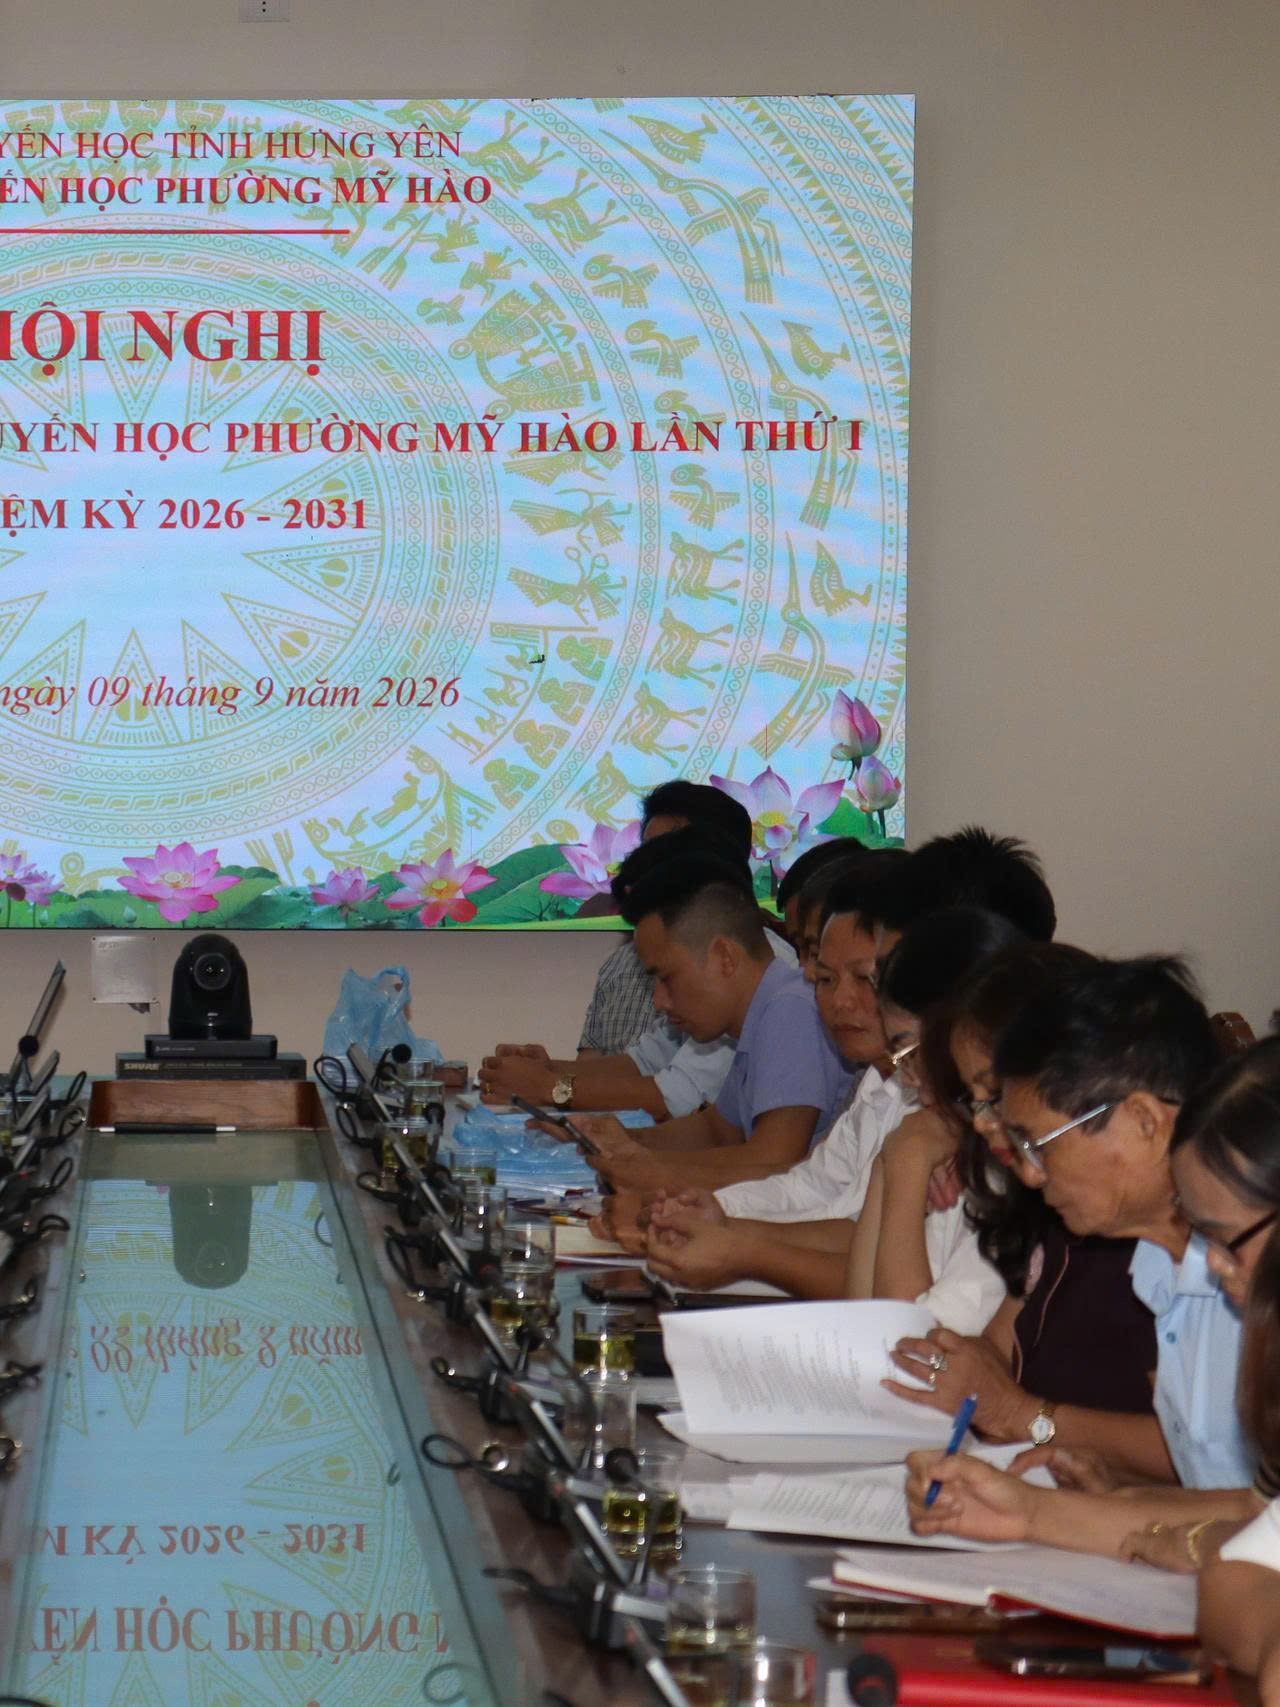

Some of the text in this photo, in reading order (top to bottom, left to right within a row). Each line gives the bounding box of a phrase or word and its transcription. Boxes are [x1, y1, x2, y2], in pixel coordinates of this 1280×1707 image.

[76, 131, 155, 164] HỌC
[164, 124, 253, 159] TỈNH
[265, 128, 375, 159] HƯNG
[386, 123, 462, 159] YÊN
[59, 176, 144, 212] HỌC
[154, 168, 321, 204] PHƯỜNG
[334, 170, 395, 204] MỸ
[404, 168, 492, 204] HÀO
[128, 308, 326, 376] NGHỊ
[113, 421, 211, 461] HỌC
[224, 412, 419, 453] PHƯỜNG
[432, 411, 503, 453] MỸ
[517, 412, 617, 453] HÀO
[630, 411, 722, 452] LẦN
[736, 411, 837, 452] THỨ
[846, 420, 863, 452] I
[82, 490, 145, 529] KỲ
[158, 498, 246, 530] 2026
[282, 498, 367, 530] 2031
[87, 676, 133, 706] 09
[141, 675, 241, 716] tháng
[255, 677, 276, 706] 9
[285, 679, 361, 708] năm
[373, 676, 462, 708] 2026
